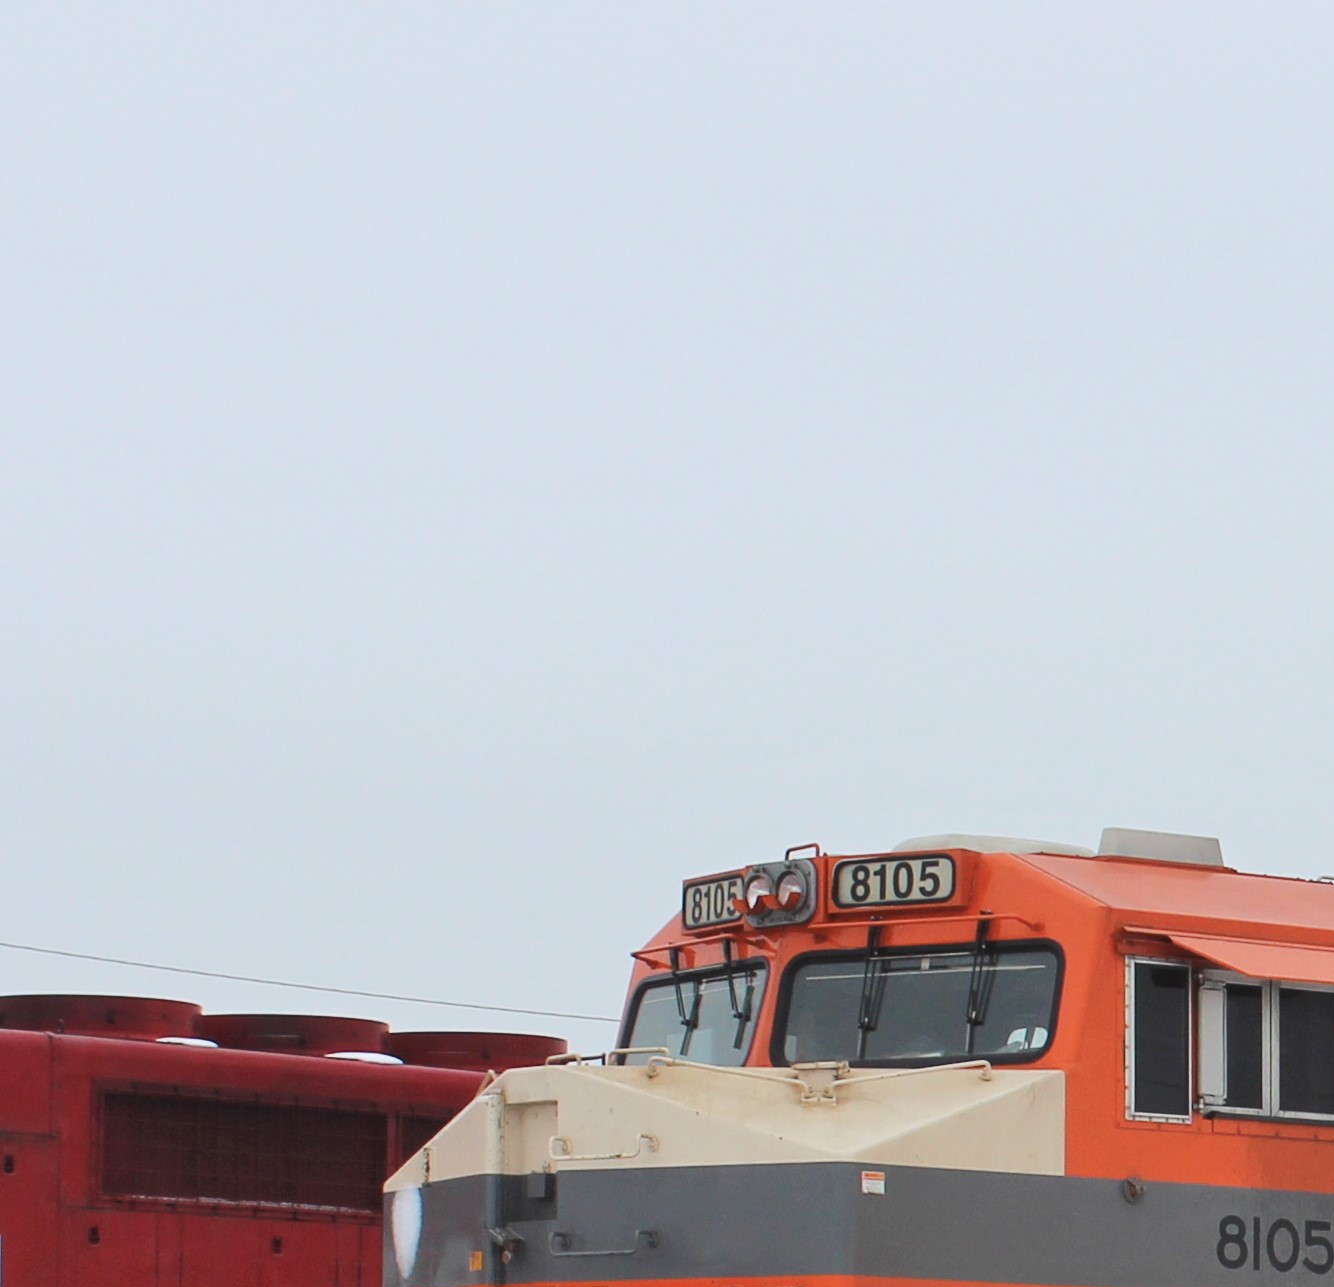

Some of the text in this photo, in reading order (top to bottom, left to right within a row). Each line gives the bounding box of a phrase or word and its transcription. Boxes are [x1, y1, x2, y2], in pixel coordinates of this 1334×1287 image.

[691, 880, 737, 924] 8105
[850, 860, 941, 903] 8105
[1216, 1214, 1334, 1275] 8105
